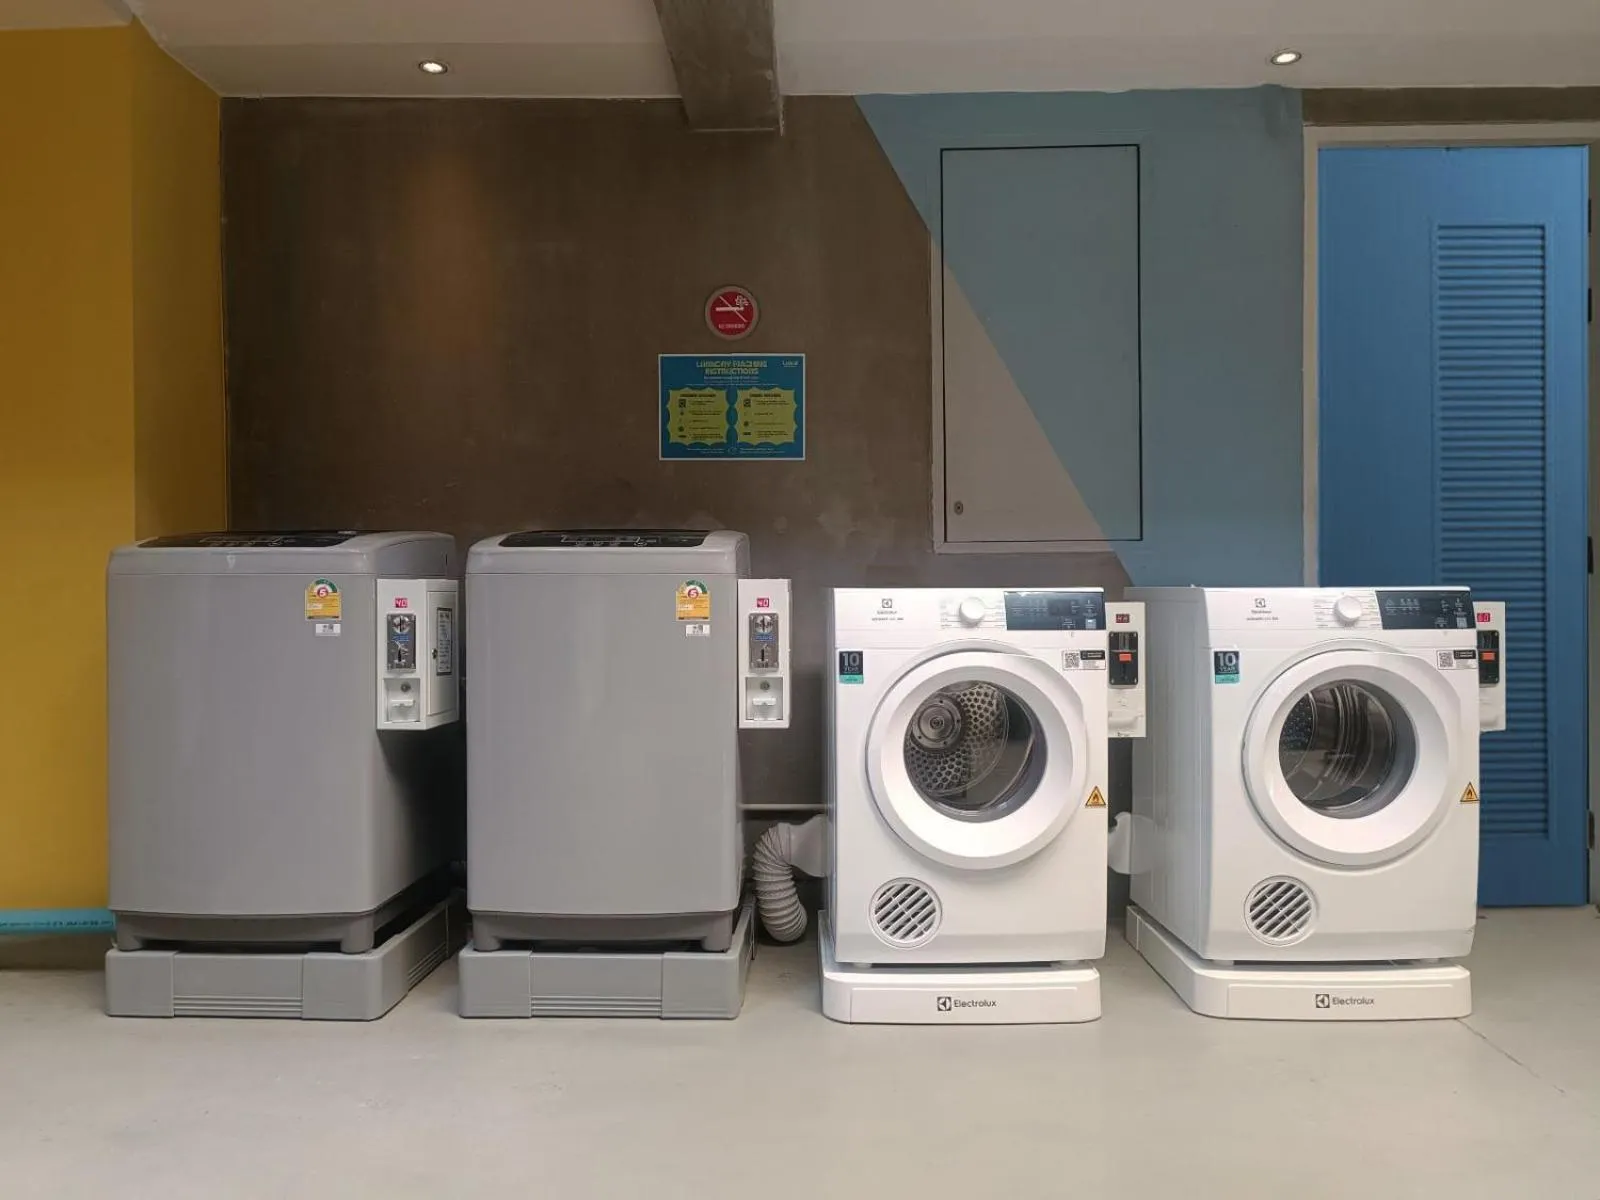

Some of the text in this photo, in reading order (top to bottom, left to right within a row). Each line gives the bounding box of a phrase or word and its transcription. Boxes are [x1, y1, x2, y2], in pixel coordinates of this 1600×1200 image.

[842, 652, 860, 666] 10
[1218, 652, 1236, 666] 10
[954, 999, 997, 1008] Electrolux
[1332, 996, 1375, 1005] Electrolux
